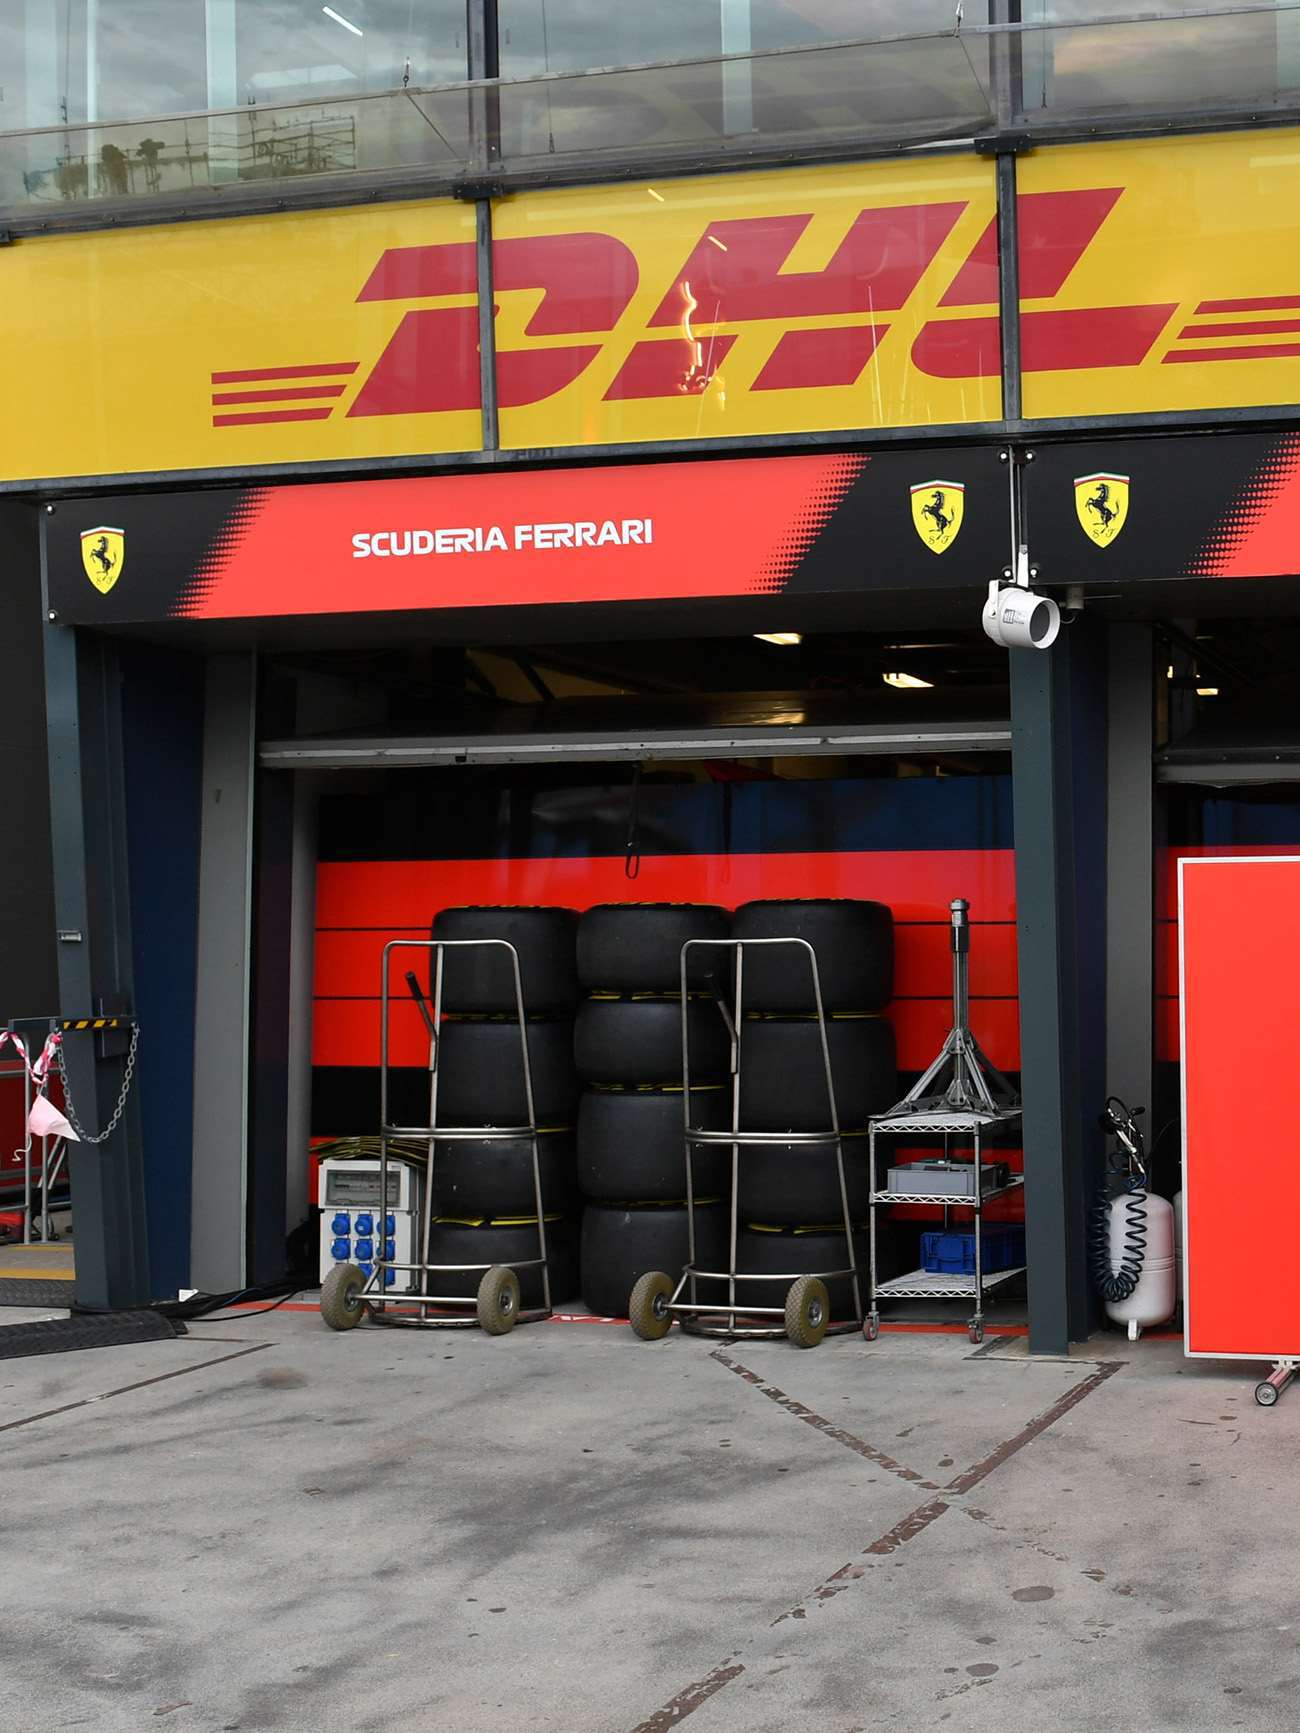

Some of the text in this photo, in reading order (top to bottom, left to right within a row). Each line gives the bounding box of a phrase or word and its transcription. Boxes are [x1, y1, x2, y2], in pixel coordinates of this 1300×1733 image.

[346, 187, 1180, 418] DHL
[352, 518, 653, 559] SCUDERIA FERRARI
